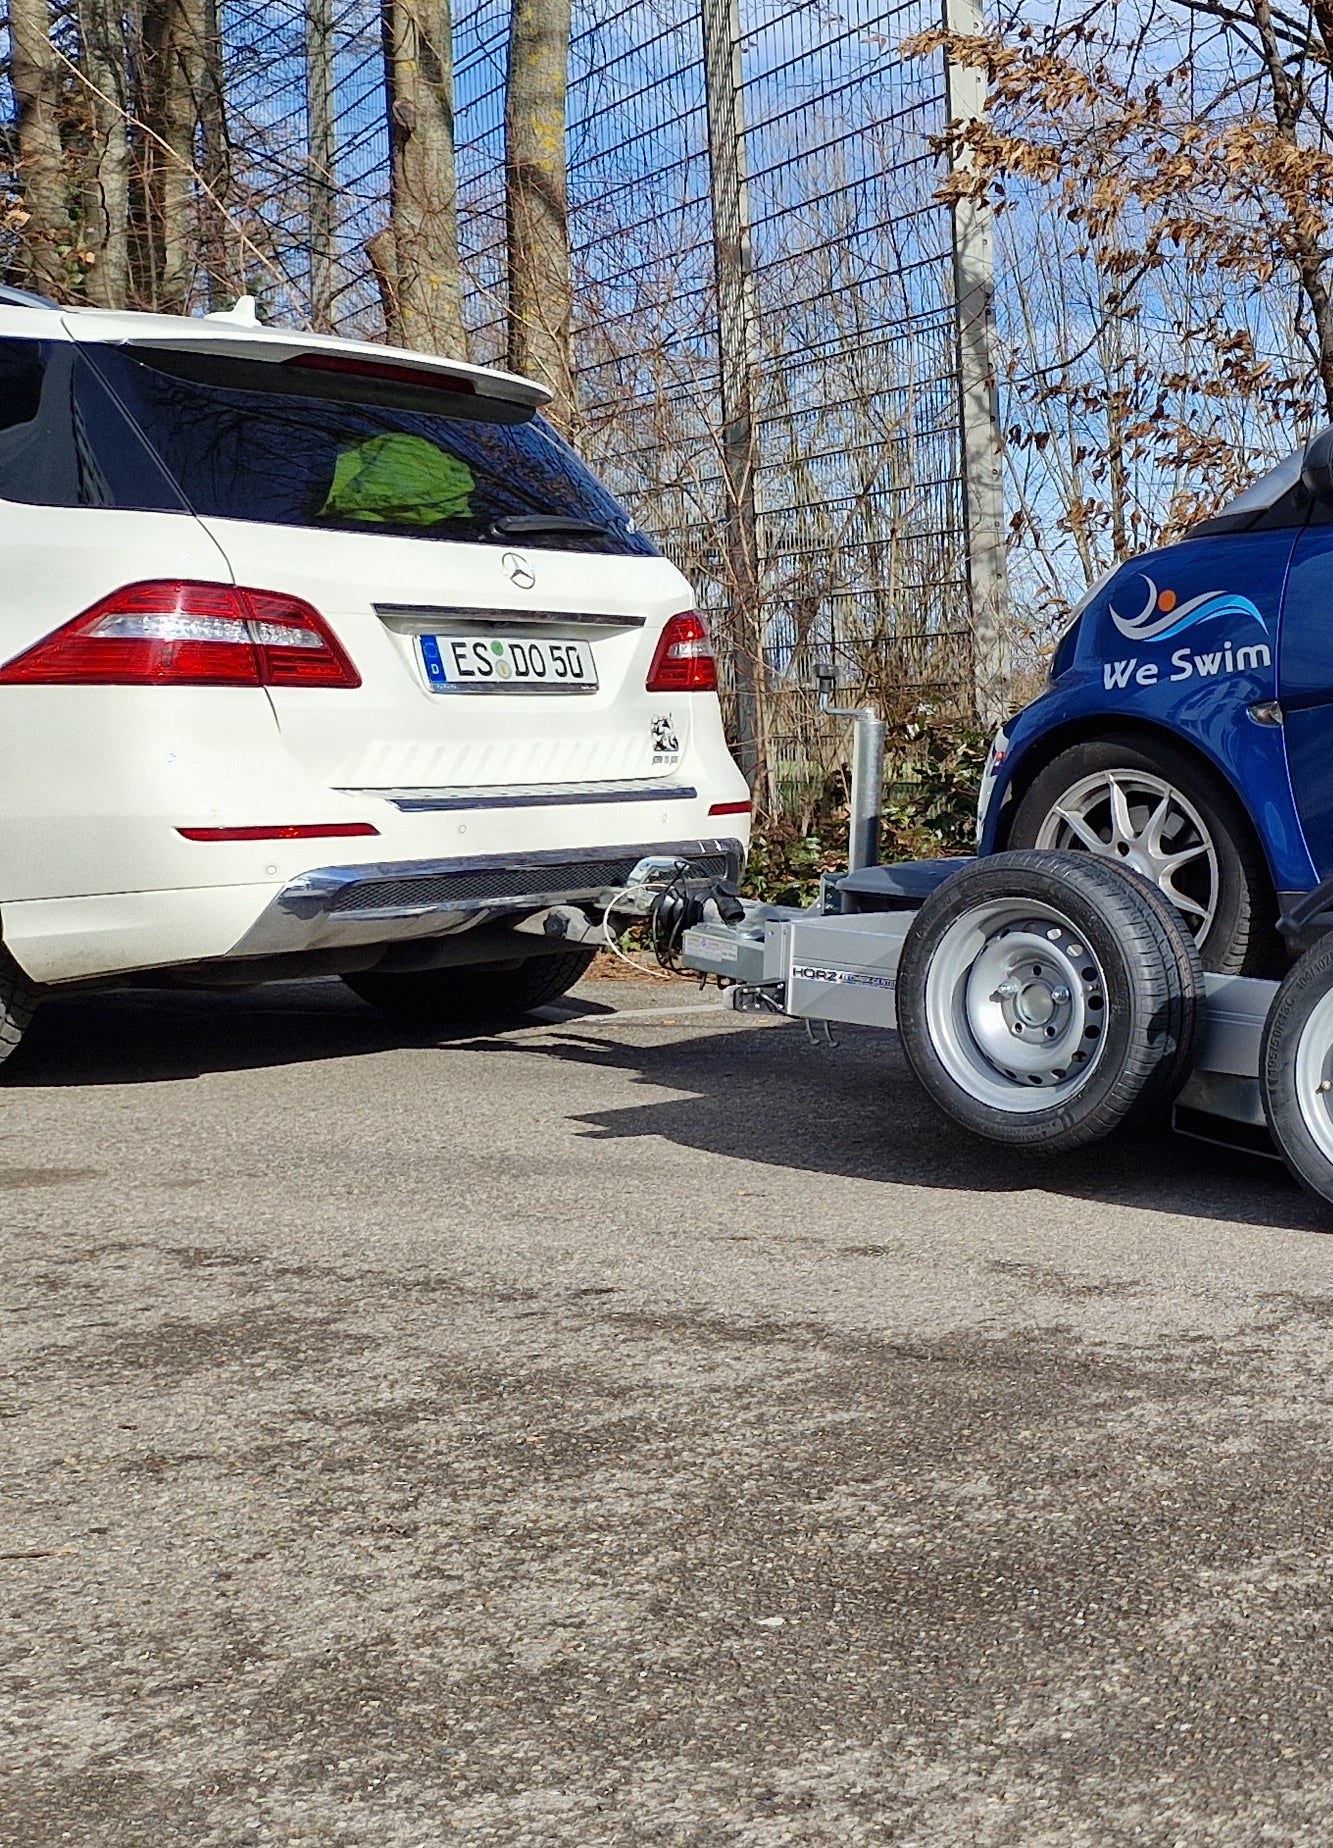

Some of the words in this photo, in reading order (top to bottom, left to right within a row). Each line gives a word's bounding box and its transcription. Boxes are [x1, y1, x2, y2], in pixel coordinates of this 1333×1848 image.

[432, 664, 440, 675] D
[450, 642, 494, 677] ES
[508, 643, 547, 678] DO
[549, 645, 585, 679] 50
[1103, 658, 1159, 690] We
[1170, 641, 1272, 682] Swim
